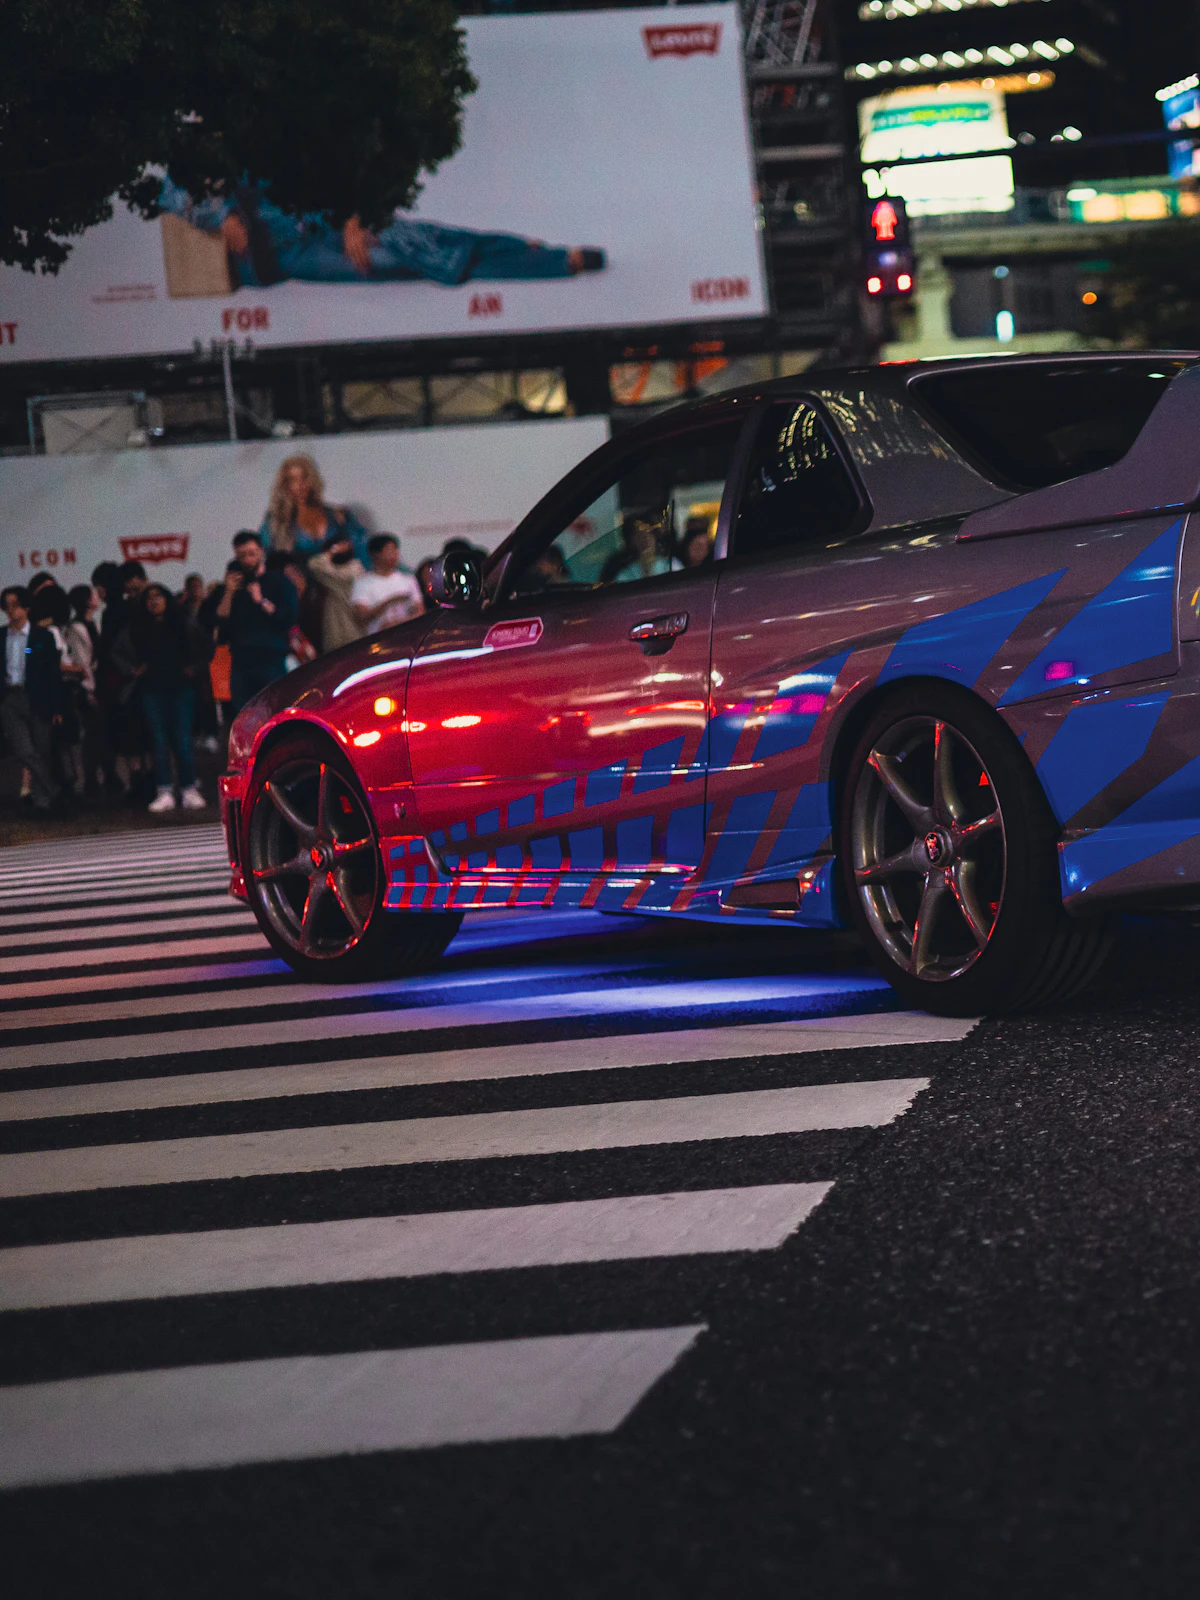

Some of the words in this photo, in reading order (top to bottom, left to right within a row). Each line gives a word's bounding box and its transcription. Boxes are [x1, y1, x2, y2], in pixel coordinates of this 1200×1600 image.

[222, 307, 270, 332] FOR
[468, 293, 503, 319] AN
[691, 276, 749, 303] ICON
[18, 548, 76, 569] ICON
